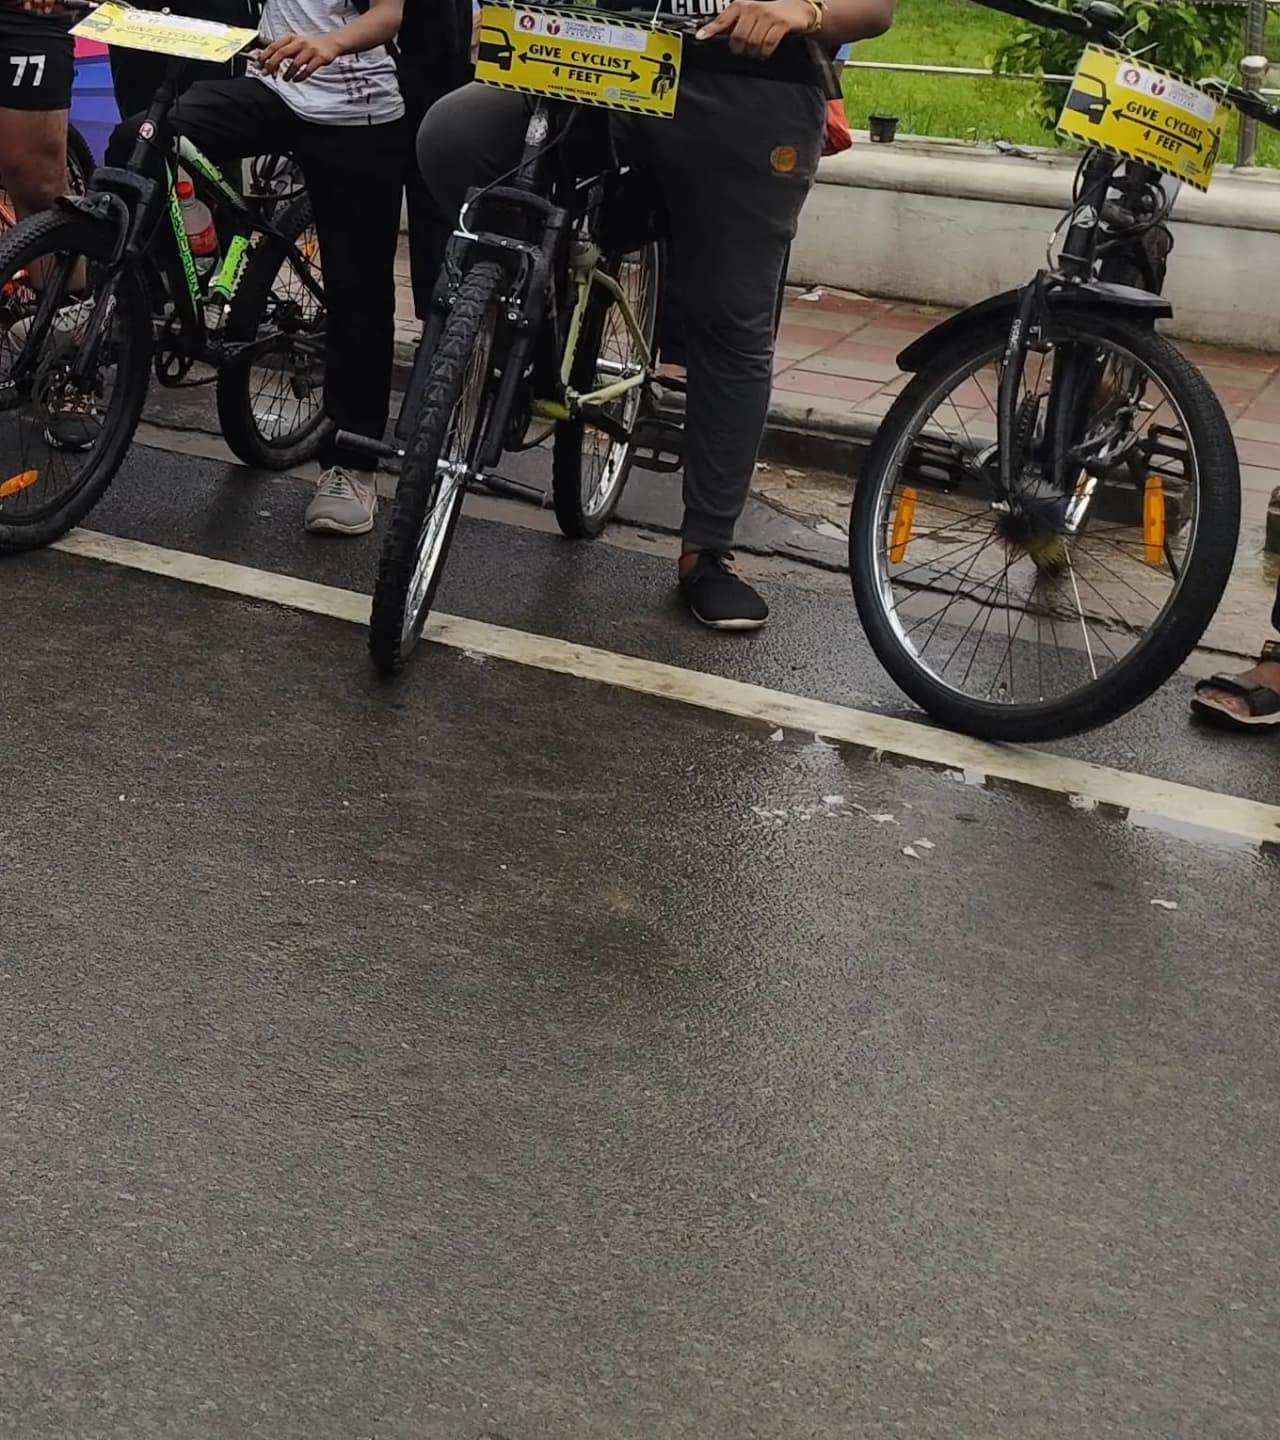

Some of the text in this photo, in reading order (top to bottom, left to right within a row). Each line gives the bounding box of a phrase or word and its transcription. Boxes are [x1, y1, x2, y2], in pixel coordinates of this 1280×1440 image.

[529, 44, 632, 70] GIVE CYCLIST
[10, 55, 46, 86] 77
[552, 66, 603, 84] 4 FEET
[1126, 101, 1203, 140] GIVE CYCLIST
[1143, 129, 1182, 154] 4 FEET
